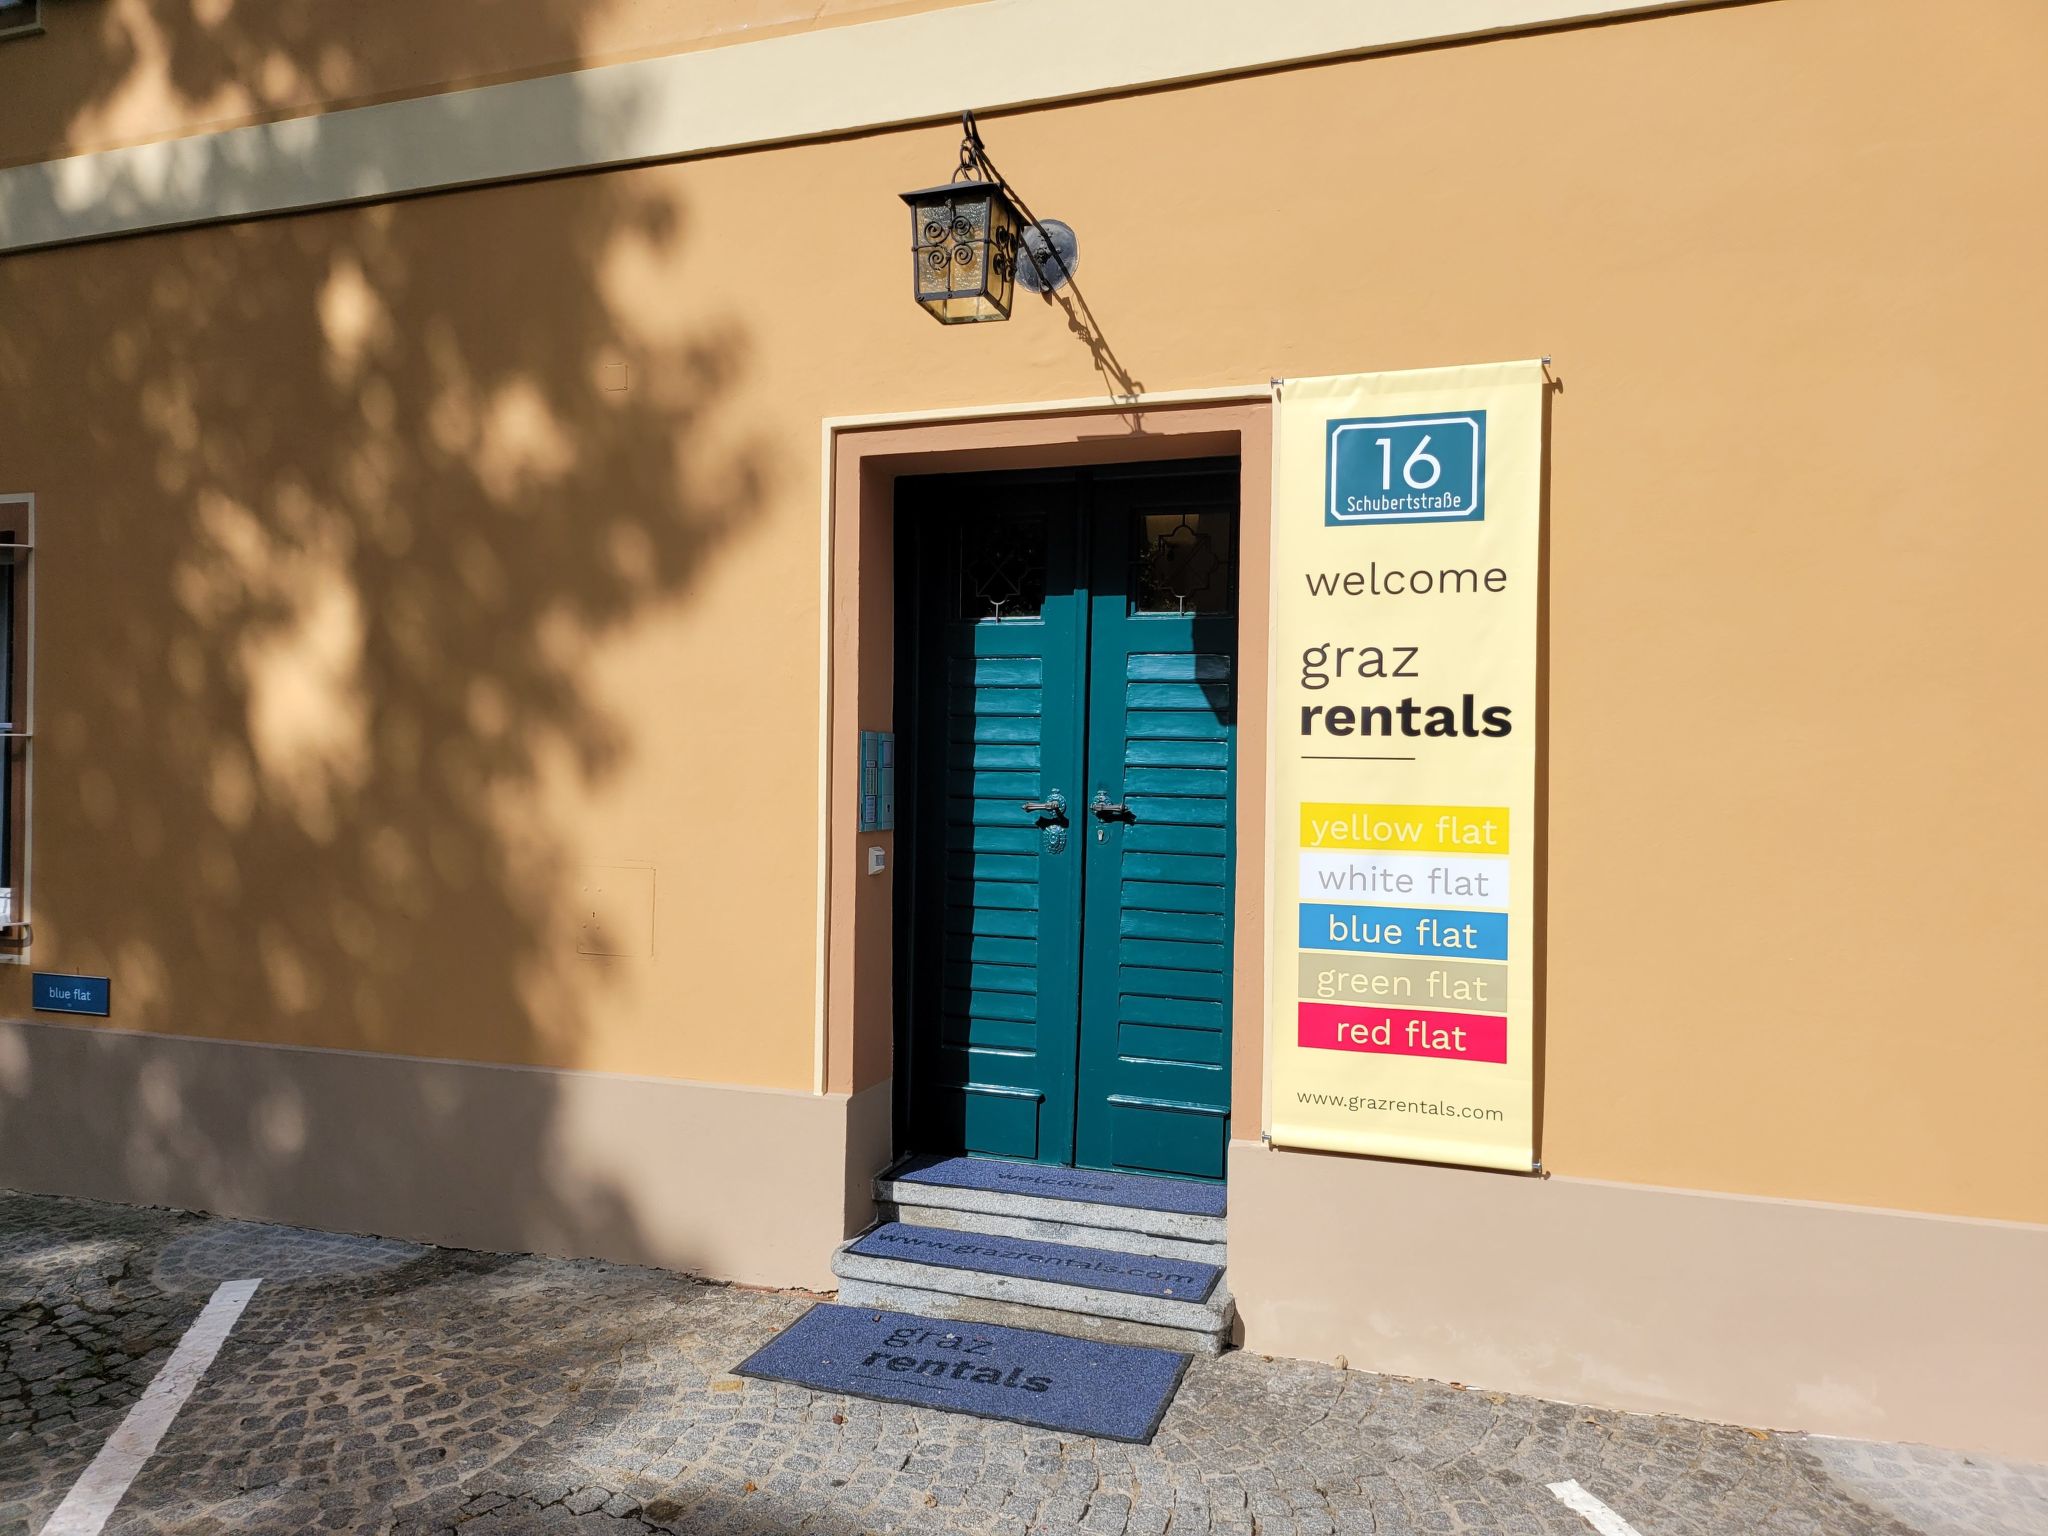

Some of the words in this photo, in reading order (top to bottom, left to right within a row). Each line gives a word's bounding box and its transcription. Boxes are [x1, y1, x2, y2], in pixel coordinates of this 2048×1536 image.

[1374, 434, 1441, 490] 16
[1346, 491, 1462, 513] Schubertstraße
[1305, 561, 1508, 597] welcome
[1300, 642, 1419, 690] graz
[1300, 693, 1513, 738] rentals
[1310, 813, 1424, 847] yellow
[1435, 815, 1498, 847] flat
[1317, 863, 1414, 894] white
[1427, 867, 1490, 897] flat
[1329, 913, 1402, 945] blue
[1416, 918, 1478, 949] flat
[49, 986, 71, 999] blue
[73, 988, 91, 1001] flat
[1317, 968, 1412, 998] green
[1426, 971, 1488, 1002] flat
[1336, 1018, 1392, 1047] red
[1405, 1020, 1467, 1052] flat
[1296, 1090, 1504, 1122] www.grazrentals.com
[998, 1170, 1116, 1192] welcome
[877, 1230, 1195, 1285] www.grazrentals.com
[883, 1325, 993, 1357] graz
[860, 1349, 1054, 1394] rentals
